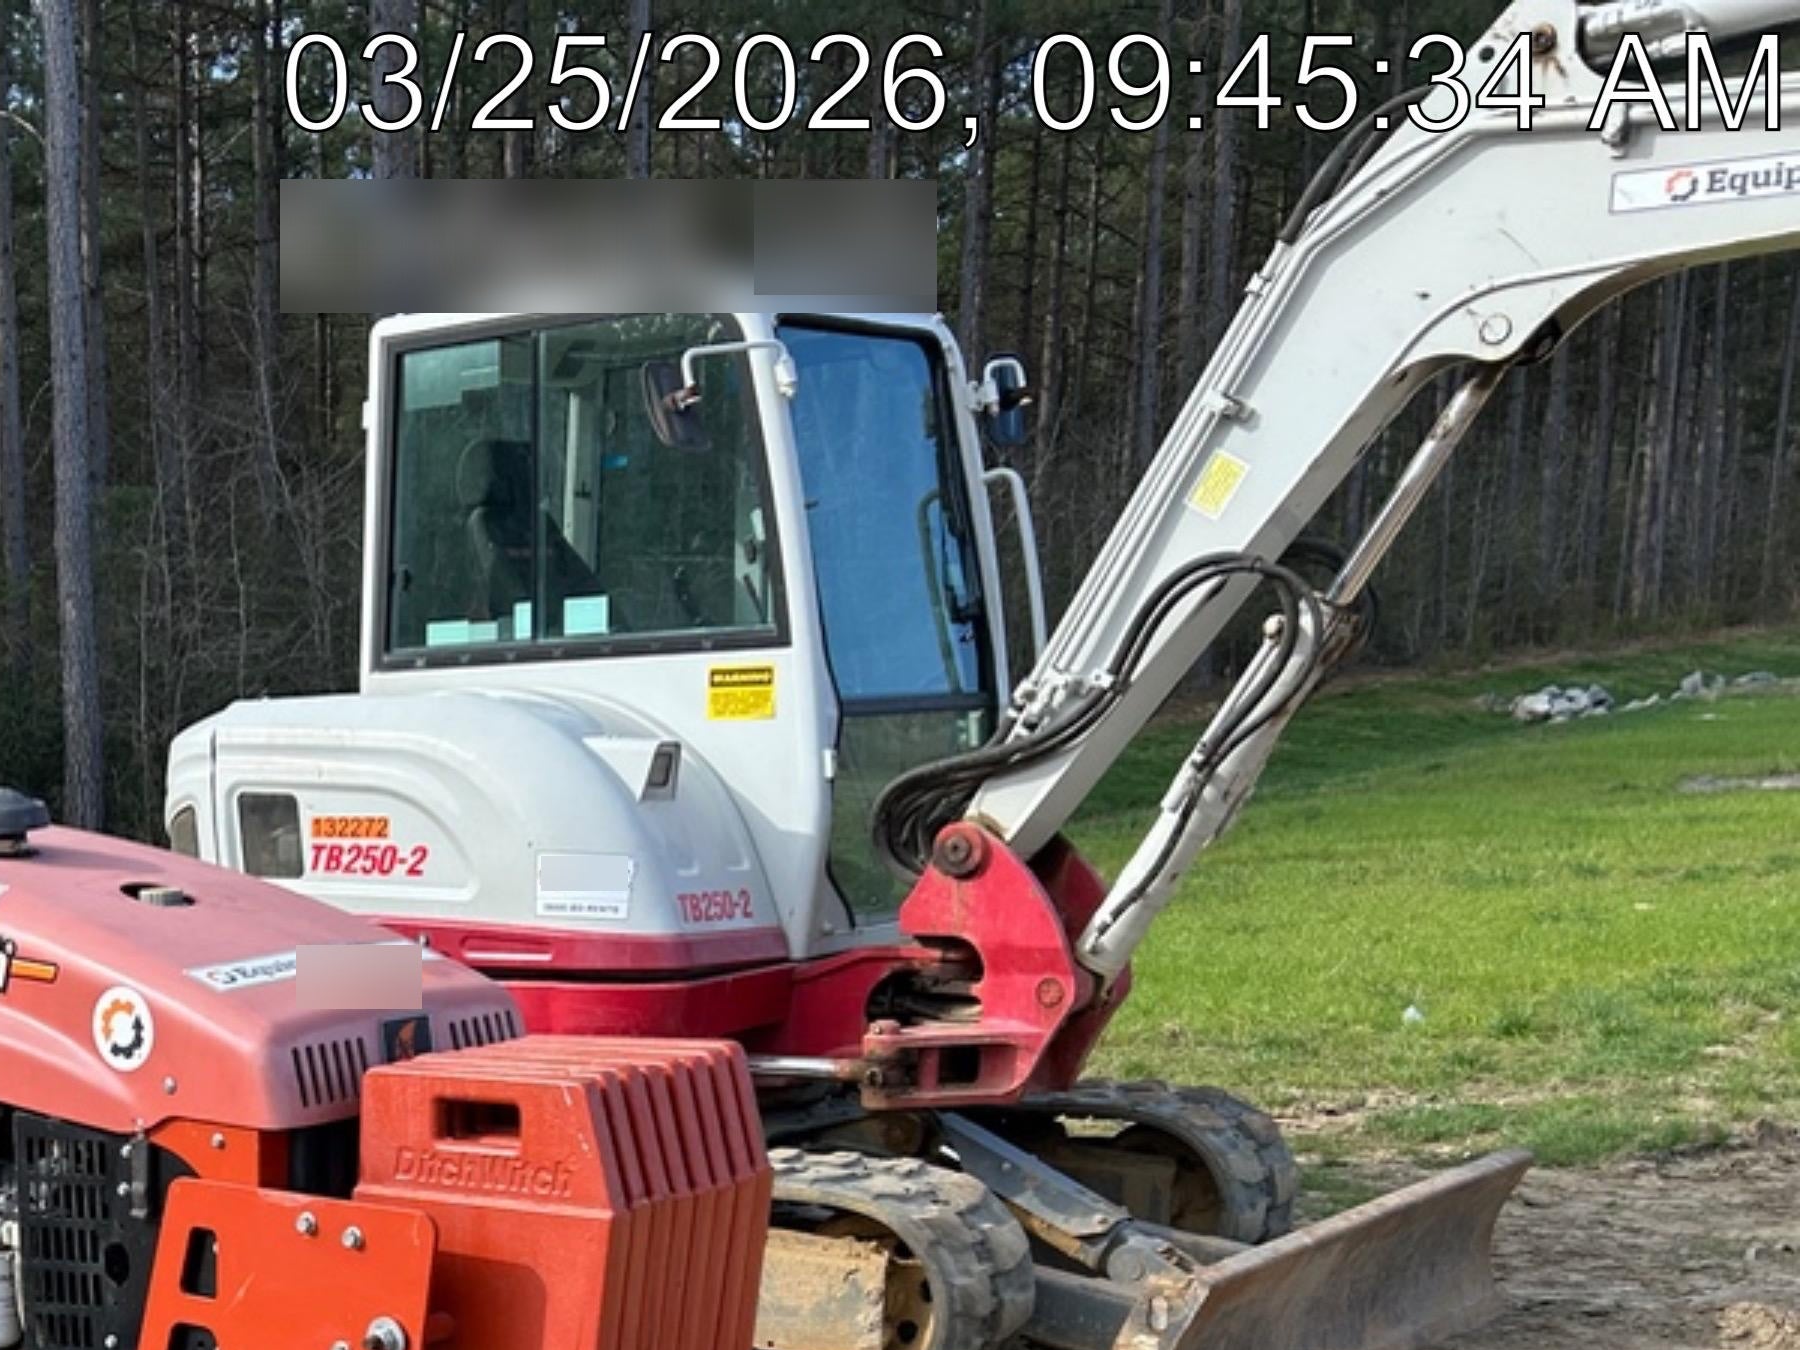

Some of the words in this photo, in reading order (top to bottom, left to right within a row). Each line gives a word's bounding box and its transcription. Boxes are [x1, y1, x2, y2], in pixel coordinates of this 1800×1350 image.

[311, 816, 388, 838] 132272
[310, 843, 429, 876] TB250-2
[677, 888, 754, 924] TB250-2
[394, 1146, 476, 1188] Ditch
[481, 1154, 575, 1198] Witch
